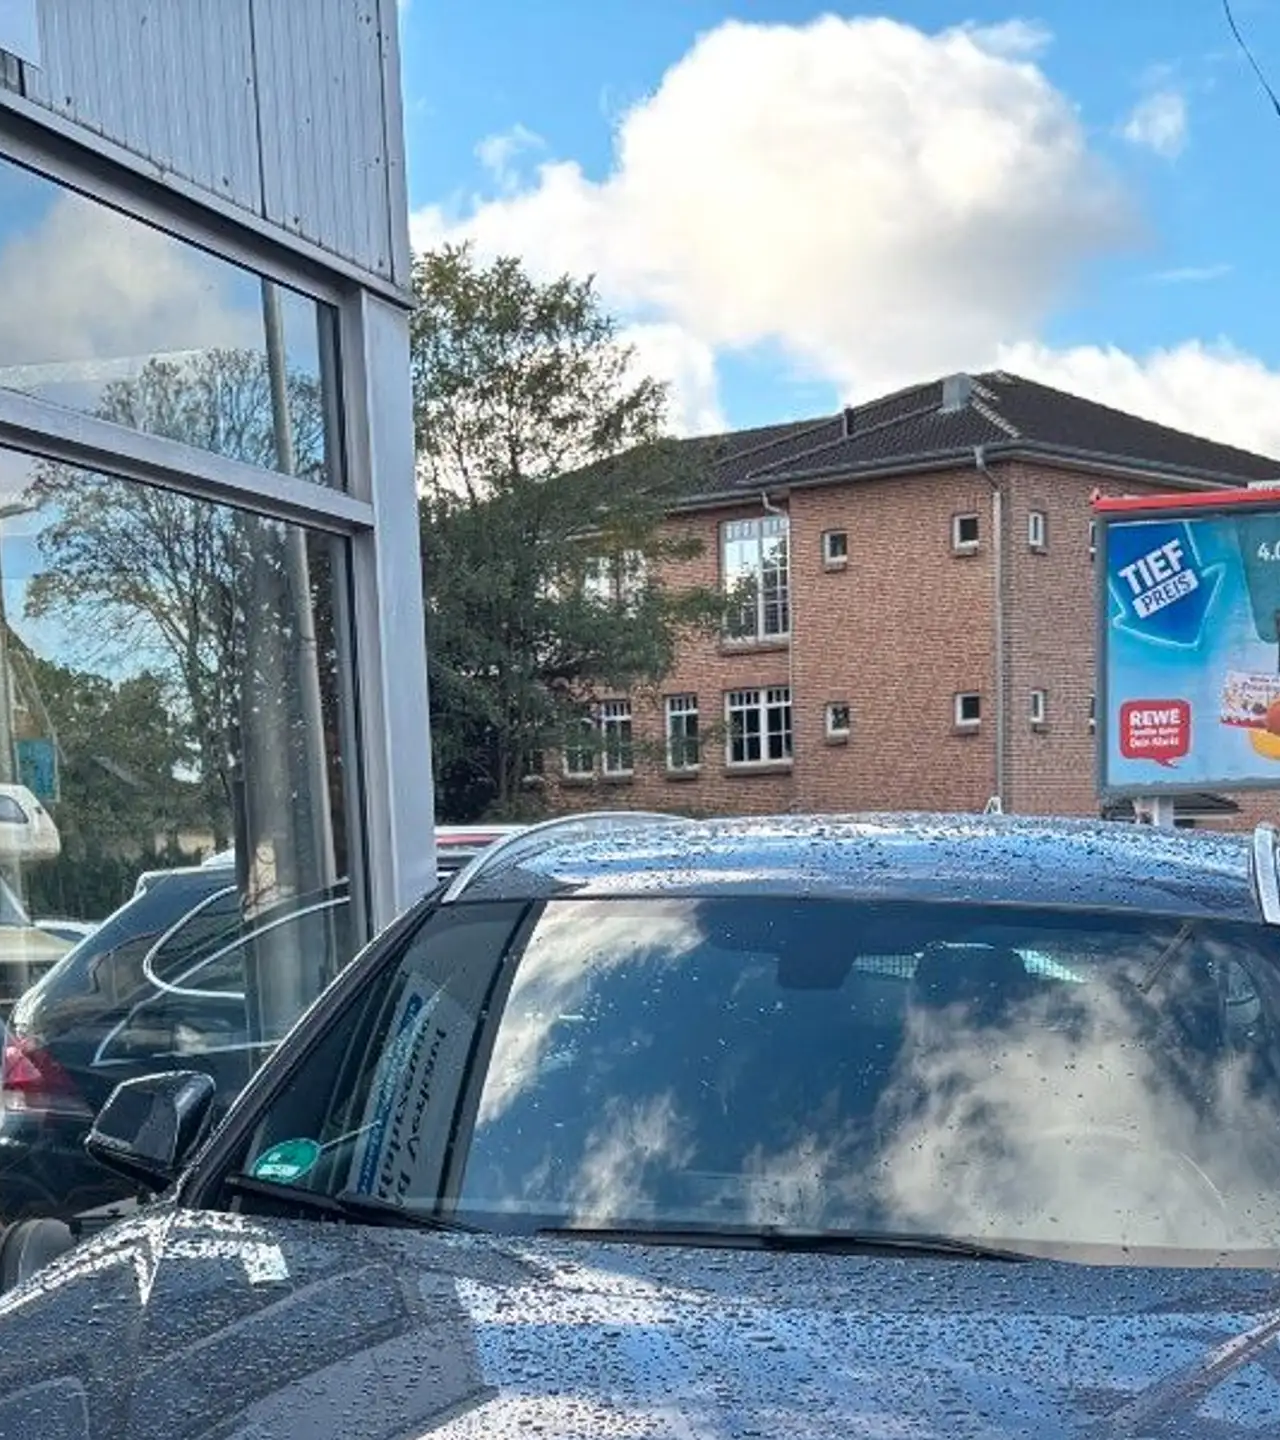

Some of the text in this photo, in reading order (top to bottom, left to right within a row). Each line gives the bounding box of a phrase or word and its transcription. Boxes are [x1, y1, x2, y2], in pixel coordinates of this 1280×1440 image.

[1118, 538, 1184, 595] TIEF
[1140, 573, 1192, 613] PREIS
[1129, 708, 1181, 727] REWE
